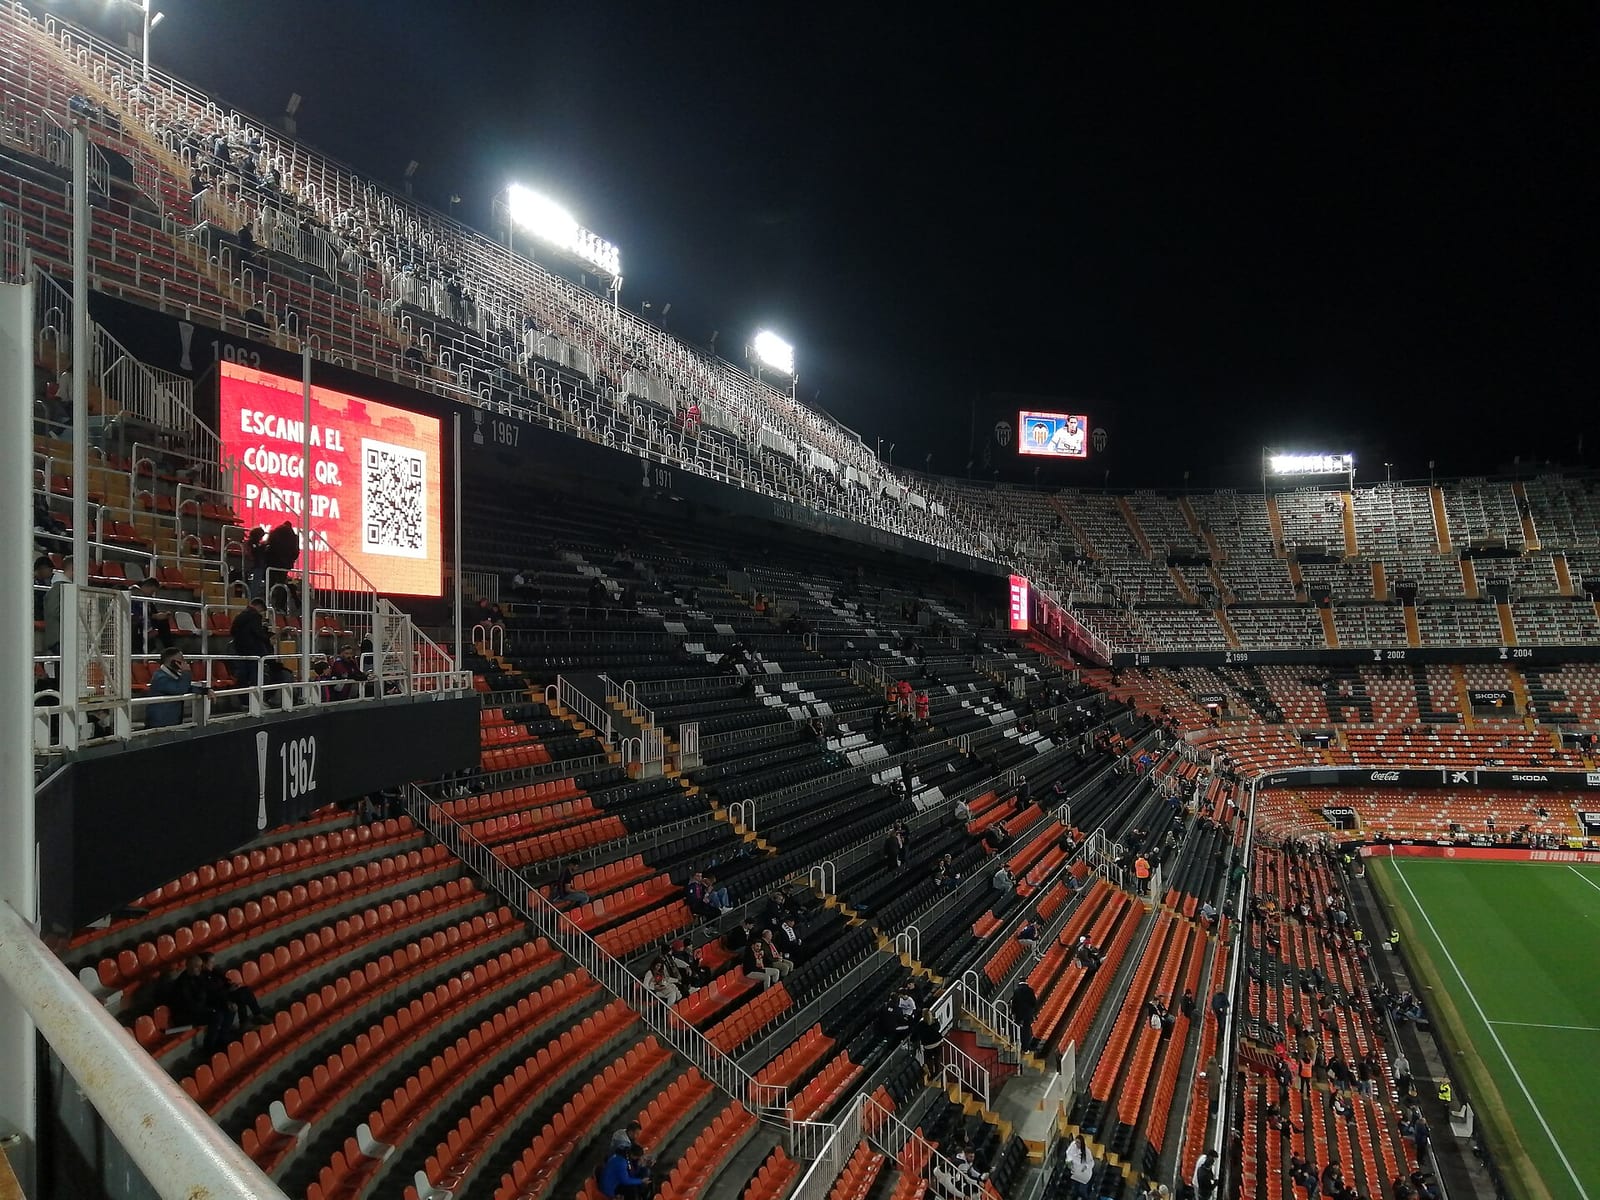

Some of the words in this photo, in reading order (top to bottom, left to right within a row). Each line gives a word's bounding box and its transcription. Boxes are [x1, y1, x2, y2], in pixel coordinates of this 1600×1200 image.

[325, 427, 344, 452] EL
[492, 420, 519, 448] 1967
[655, 468, 672, 489] 1971
[1387, 651, 1406, 659] 2002
[1513, 649, 1533, 658] 2004
[280, 735, 317, 801] 1962
